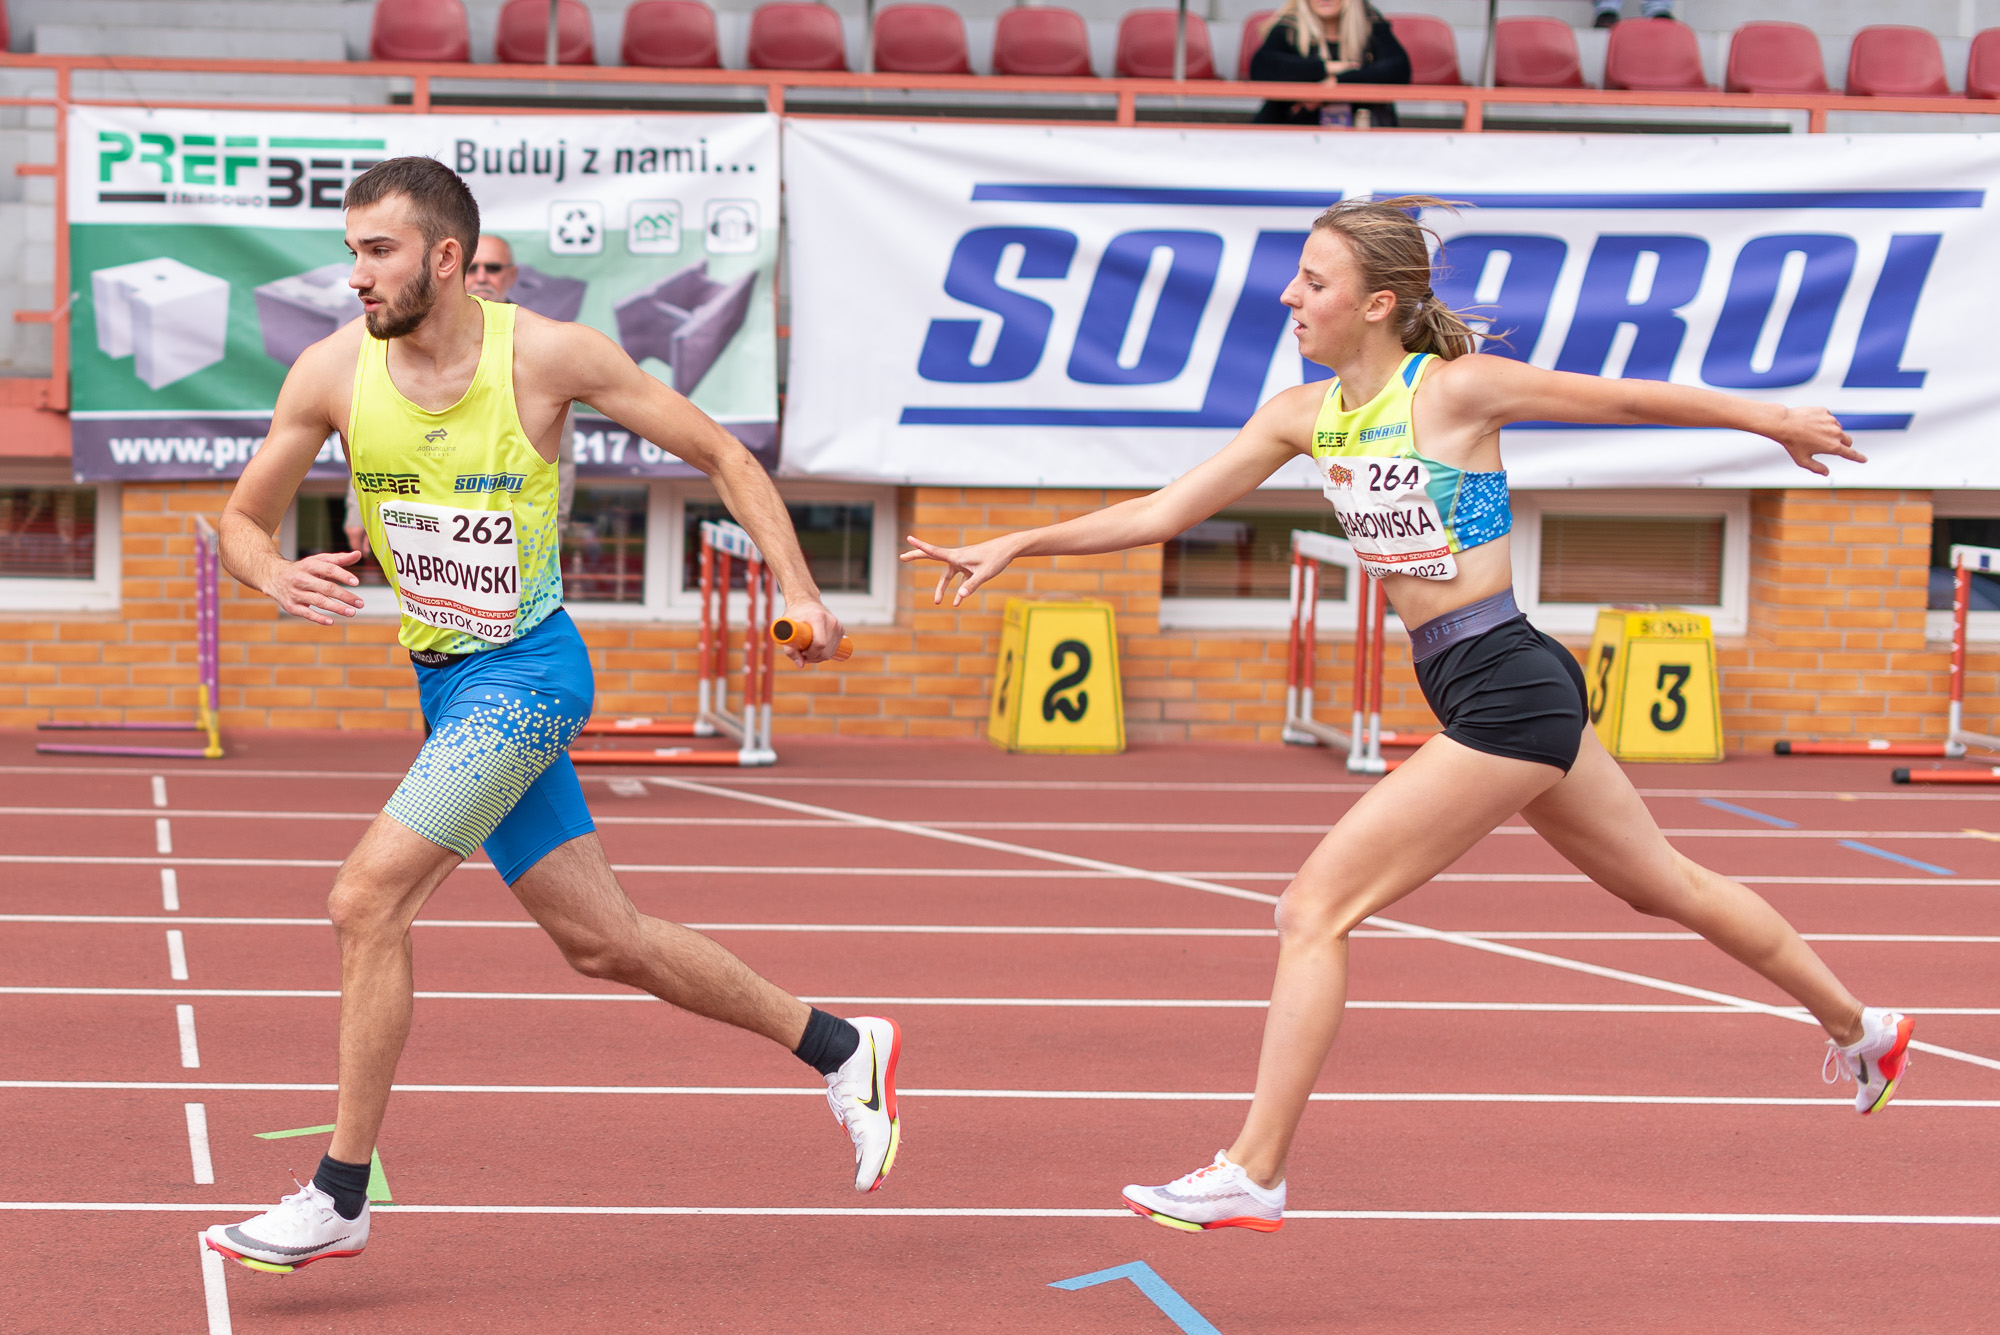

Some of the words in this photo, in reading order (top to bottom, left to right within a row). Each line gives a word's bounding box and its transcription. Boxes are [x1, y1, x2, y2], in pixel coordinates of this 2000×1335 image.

[98, 130, 386, 209] PREFBE
[456, 139, 566, 183] Buduj
[582, 149, 599, 174] z
[614, 138, 756, 174] nami...
[1360, 423, 1407, 443] SONAROL
[355, 471, 421, 495] PREFBET
[454, 471, 527, 494] SONAROL
[1368, 463, 1419, 492] 264
[382, 508, 440, 534] PREFBET
[452, 515, 513, 545] 262
[1335, 506, 1437, 540] RABOWSKA
[391, 548, 517, 595] DĄBROWSKI
[1410, 562, 1447, 578] 2022
[405, 600, 474, 632] BIAŁYSTOK
[476, 622, 512, 638] 2022
[478, 609, 517, 619] SZTAFETACH
[1043, 639, 1092, 723] 2
[1590, 645, 1616, 725] 3
[1650, 664, 1692, 732] 3
